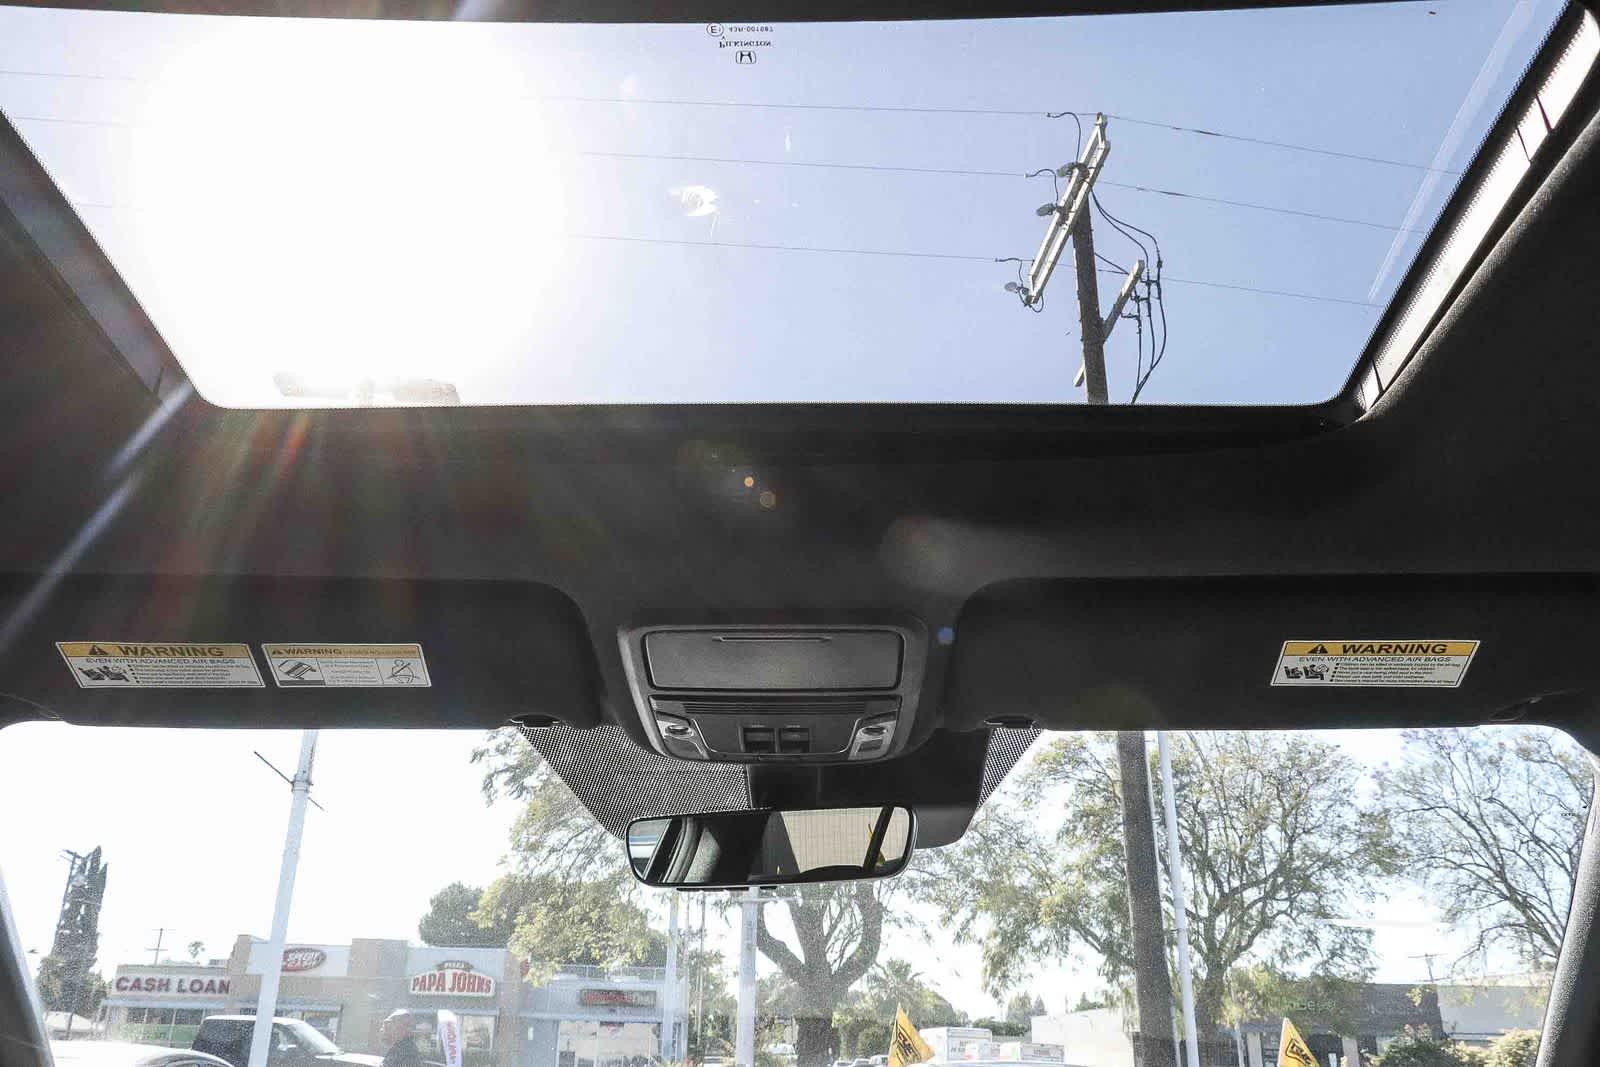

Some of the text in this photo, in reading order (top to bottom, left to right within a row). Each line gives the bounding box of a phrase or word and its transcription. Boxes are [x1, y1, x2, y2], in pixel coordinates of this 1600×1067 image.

[117, 646, 224, 657] WARNING
[287, 648, 343, 656] WARNING
[1341, 643, 1448, 655] WARNING
[115, 976, 231, 995] CASH LOAN
[411, 971, 492, 993] PAPA JOHNS
